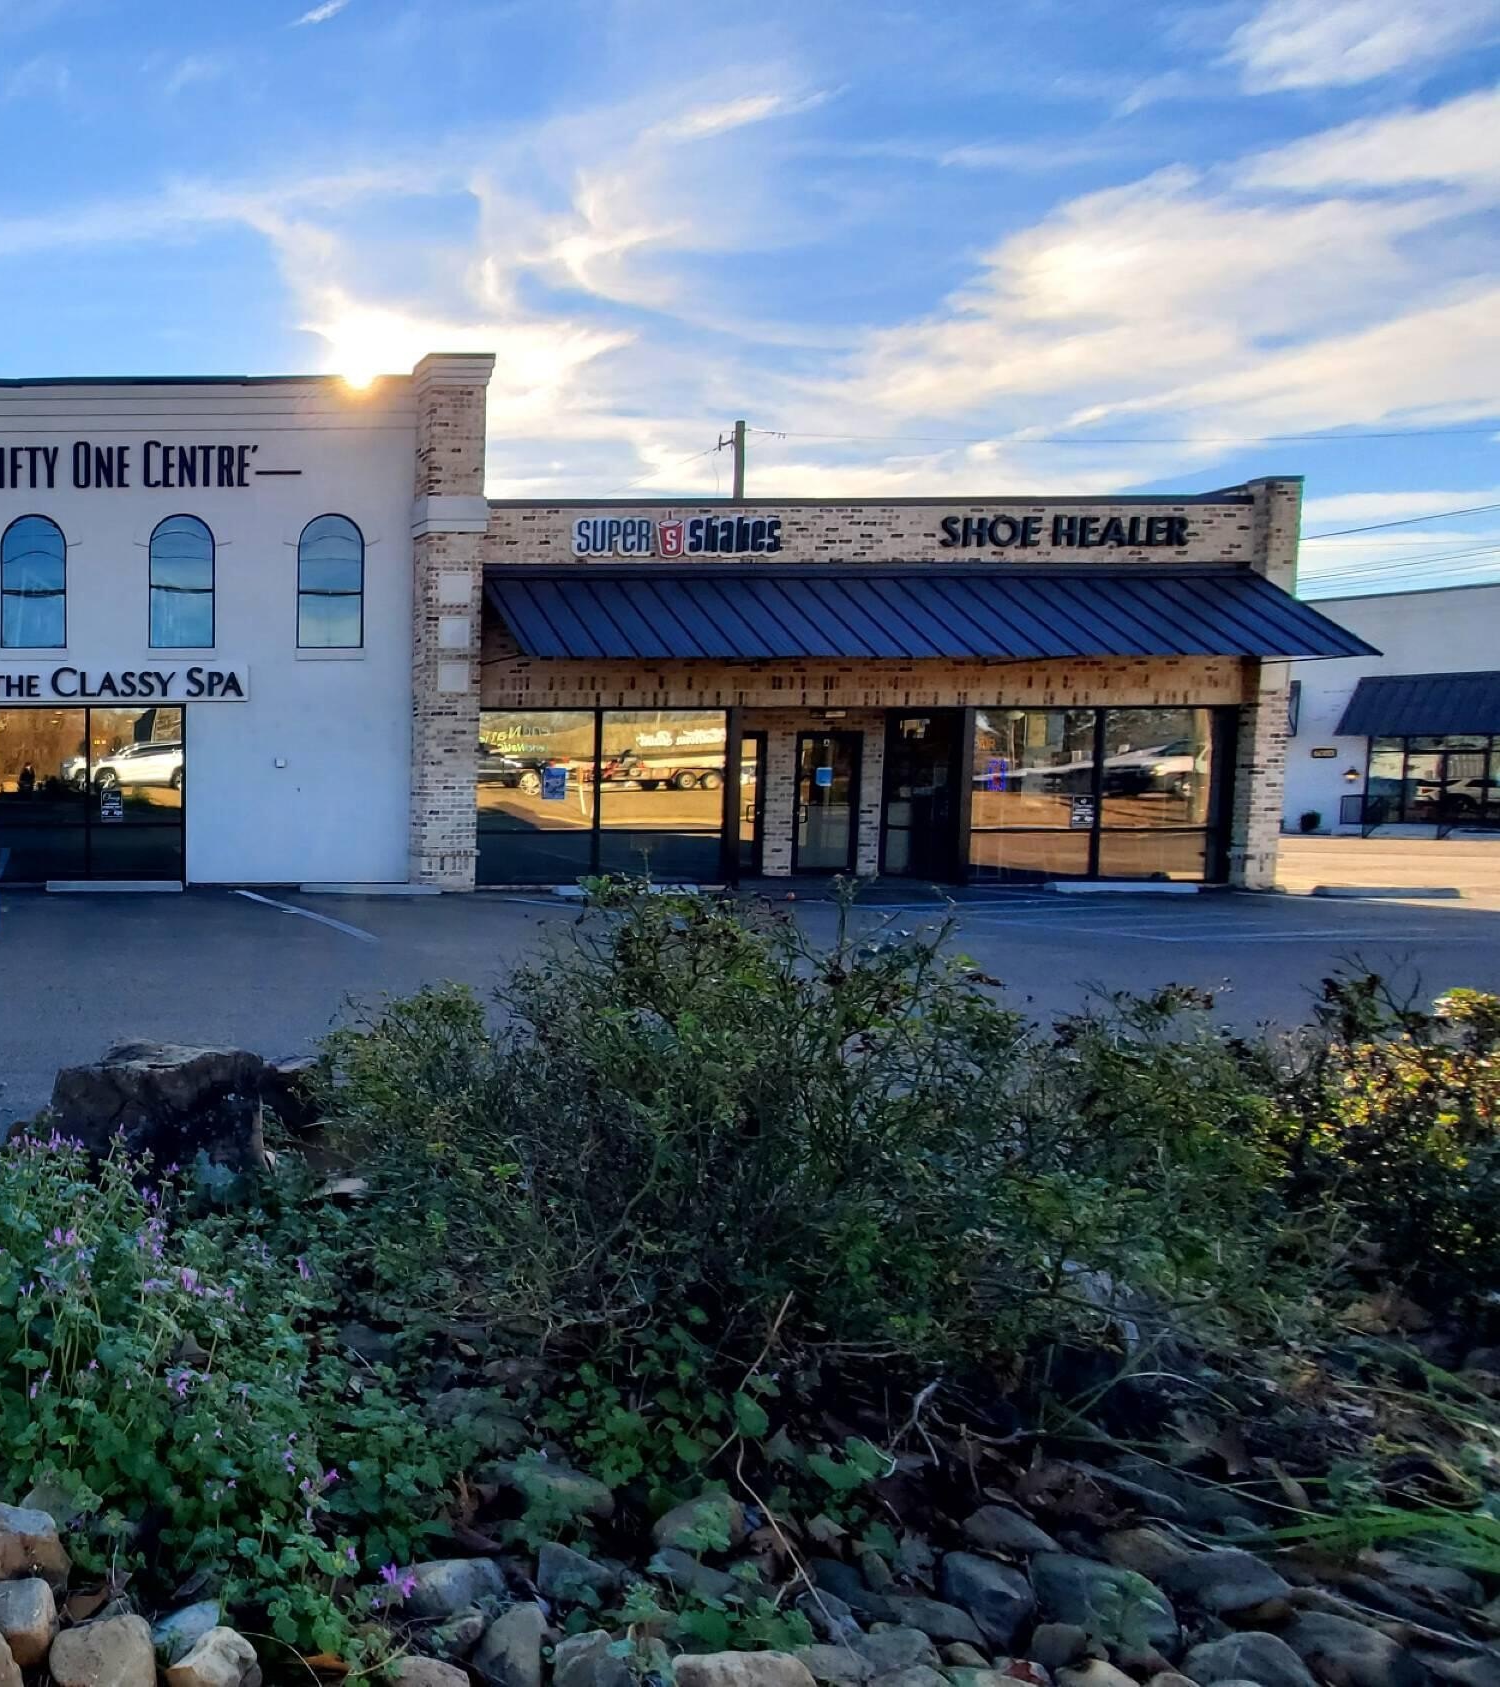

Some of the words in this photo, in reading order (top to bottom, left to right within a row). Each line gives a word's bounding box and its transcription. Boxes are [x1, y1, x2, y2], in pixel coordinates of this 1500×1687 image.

[73, 441, 130, 489] ONE
[939, 515, 1043, 547] SHOE
[1052, 516, 1190, 547] HEALER
[50, 667, 177, 697] CLASSY
[185, 666, 245, 697] SPA
